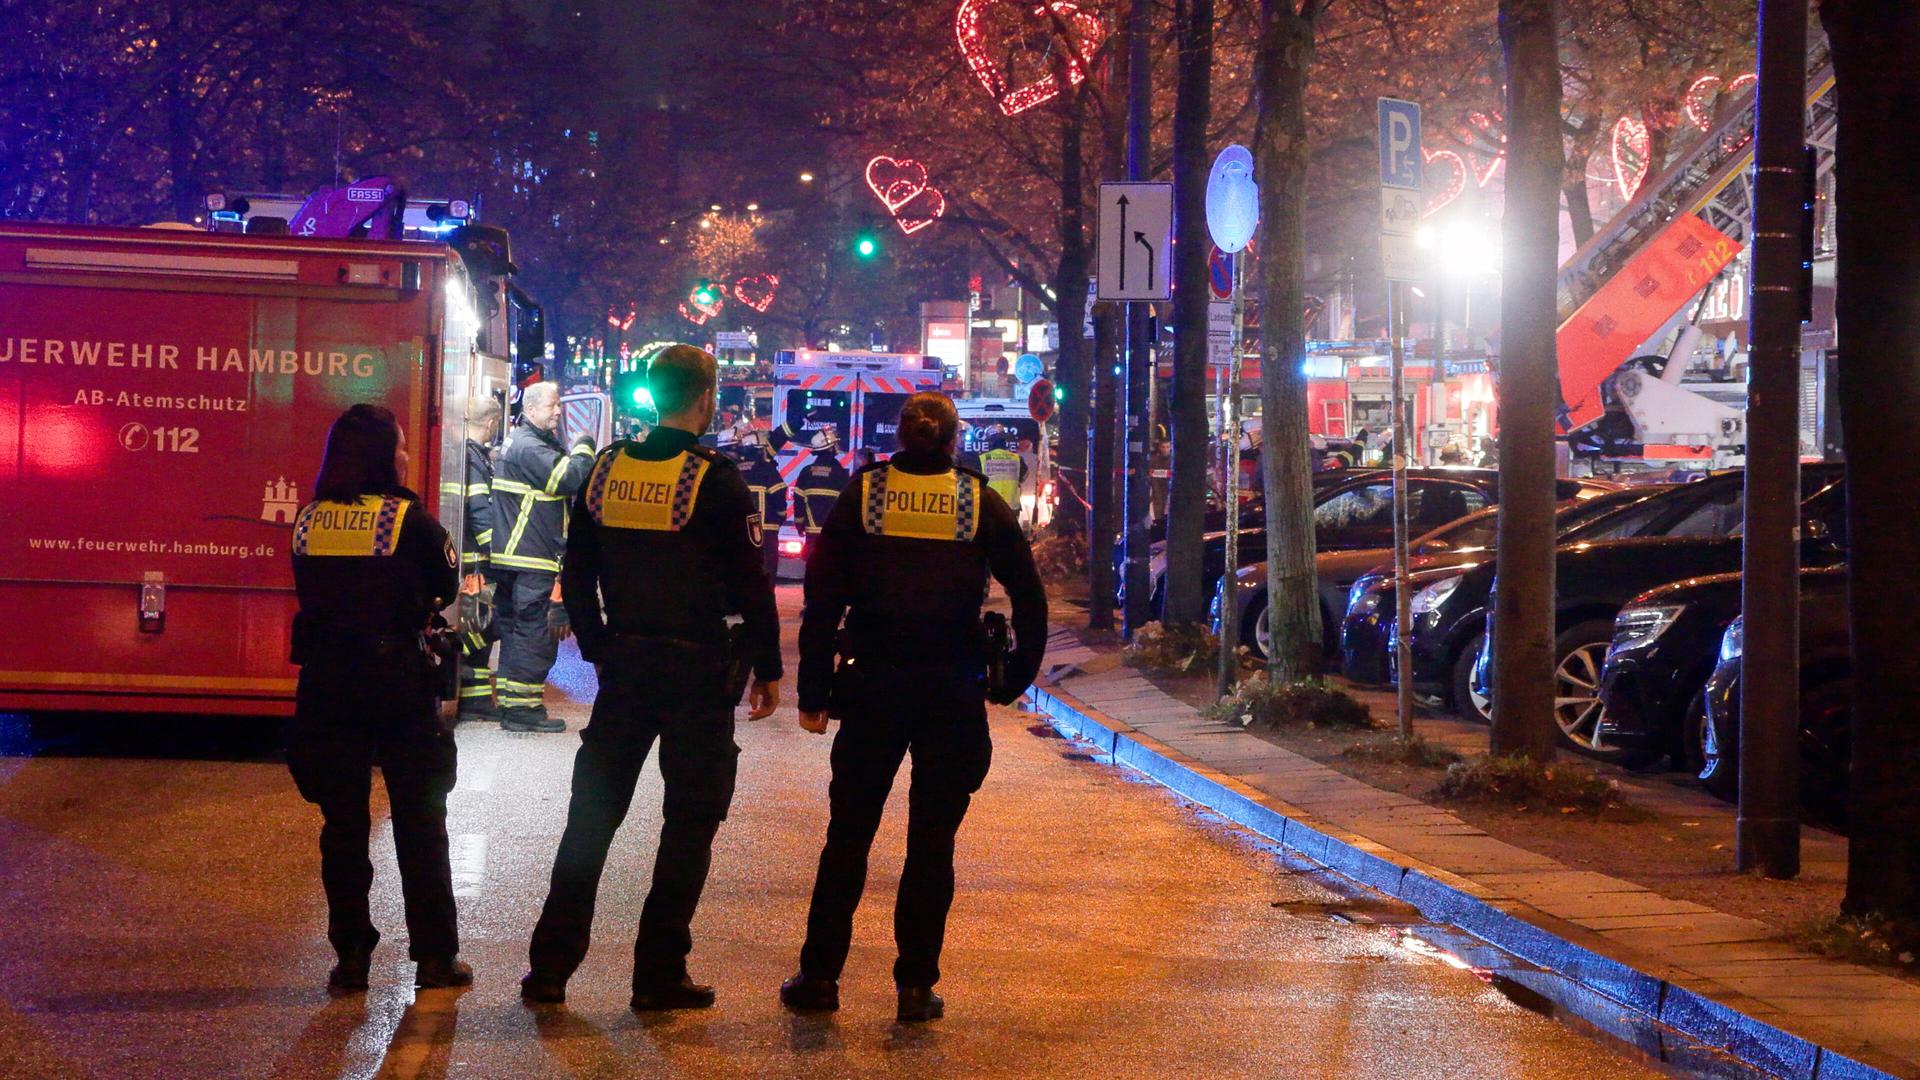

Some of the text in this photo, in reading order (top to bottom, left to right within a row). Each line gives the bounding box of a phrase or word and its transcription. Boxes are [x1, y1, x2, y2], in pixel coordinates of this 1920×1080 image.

[350, 190, 382, 200] FASSI
[1700, 240, 1733, 274] 112
[196, 346, 375, 377] HAMBURG
[74, 389, 247, 412] AB-Atemschutz
[152, 425, 200, 453] 112
[606, 479, 672, 505] POLIZEI
[885, 490, 956, 515] POLIZEI
[312, 510, 377, 531] POLIZEI
[29, 537, 275, 559] www.feuerwehr.hamburg.de
